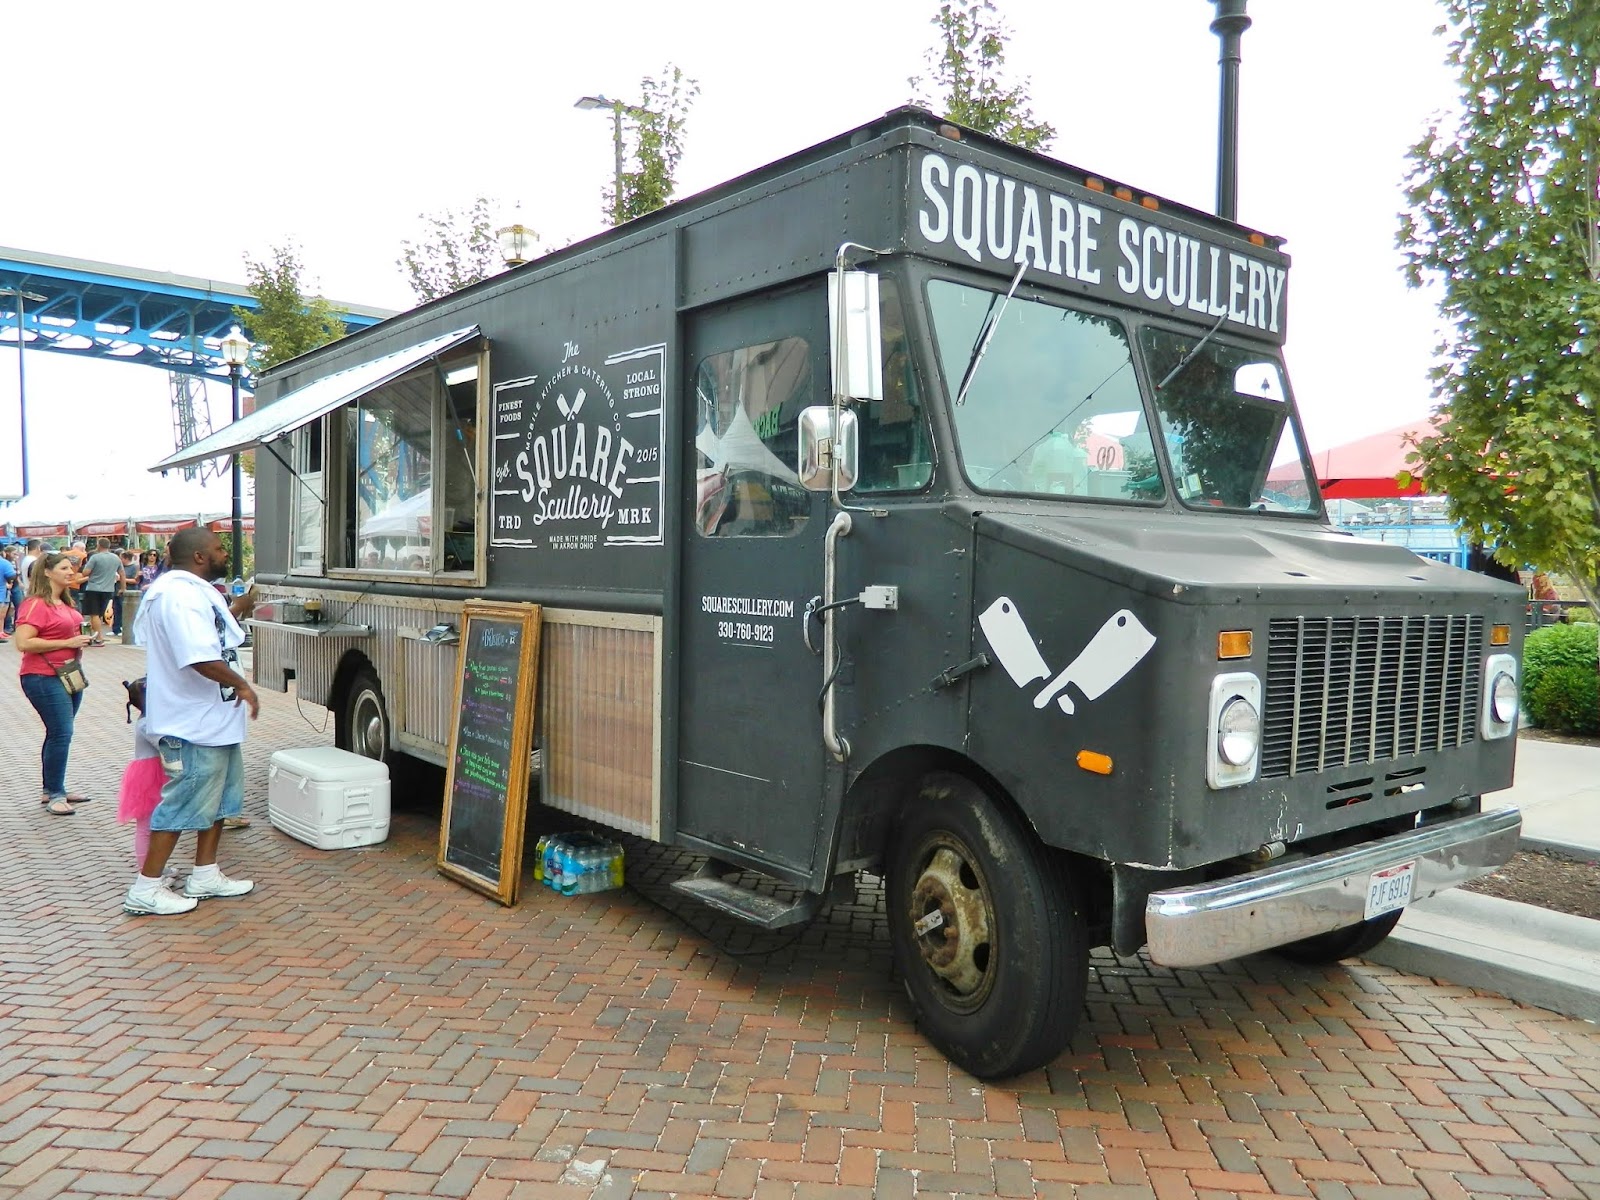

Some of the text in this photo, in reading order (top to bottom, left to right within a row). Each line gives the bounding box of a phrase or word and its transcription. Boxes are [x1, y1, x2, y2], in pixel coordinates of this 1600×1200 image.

[919, 154, 1286, 333] SQUARE SCULLERY
[562, 340, 580, 364] The
[626, 369, 656, 385] LOCAL
[623, 383, 660, 400] STRONG
[498, 400, 523, 412] FINEST
[525, 401, 542, 451] MOBILE
[541, 366, 572, 400] KITCHEN
[573, 364, 579, 374] &
[581, 365, 615, 409] CATERING
[499, 412, 522, 424] FOODS
[516, 422, 634, 503] SQUARE
[636, 447, 658, 463] 2015
[533, 484, 614, 530] Scullery
[617, 507, 652, 525] MRK
[498, 515, 522, 530] TRD
[549, 534, 598, 543] MADE WITH PRIDE
[552, 542, 594, 550] IN AKRON OHIO
[701, 595, 794, 618] SQUARESCULLERY.COM
[718, 621, 774, 643] 330-760-9123
[1369, 874, 1412, 908] PJF 6913
